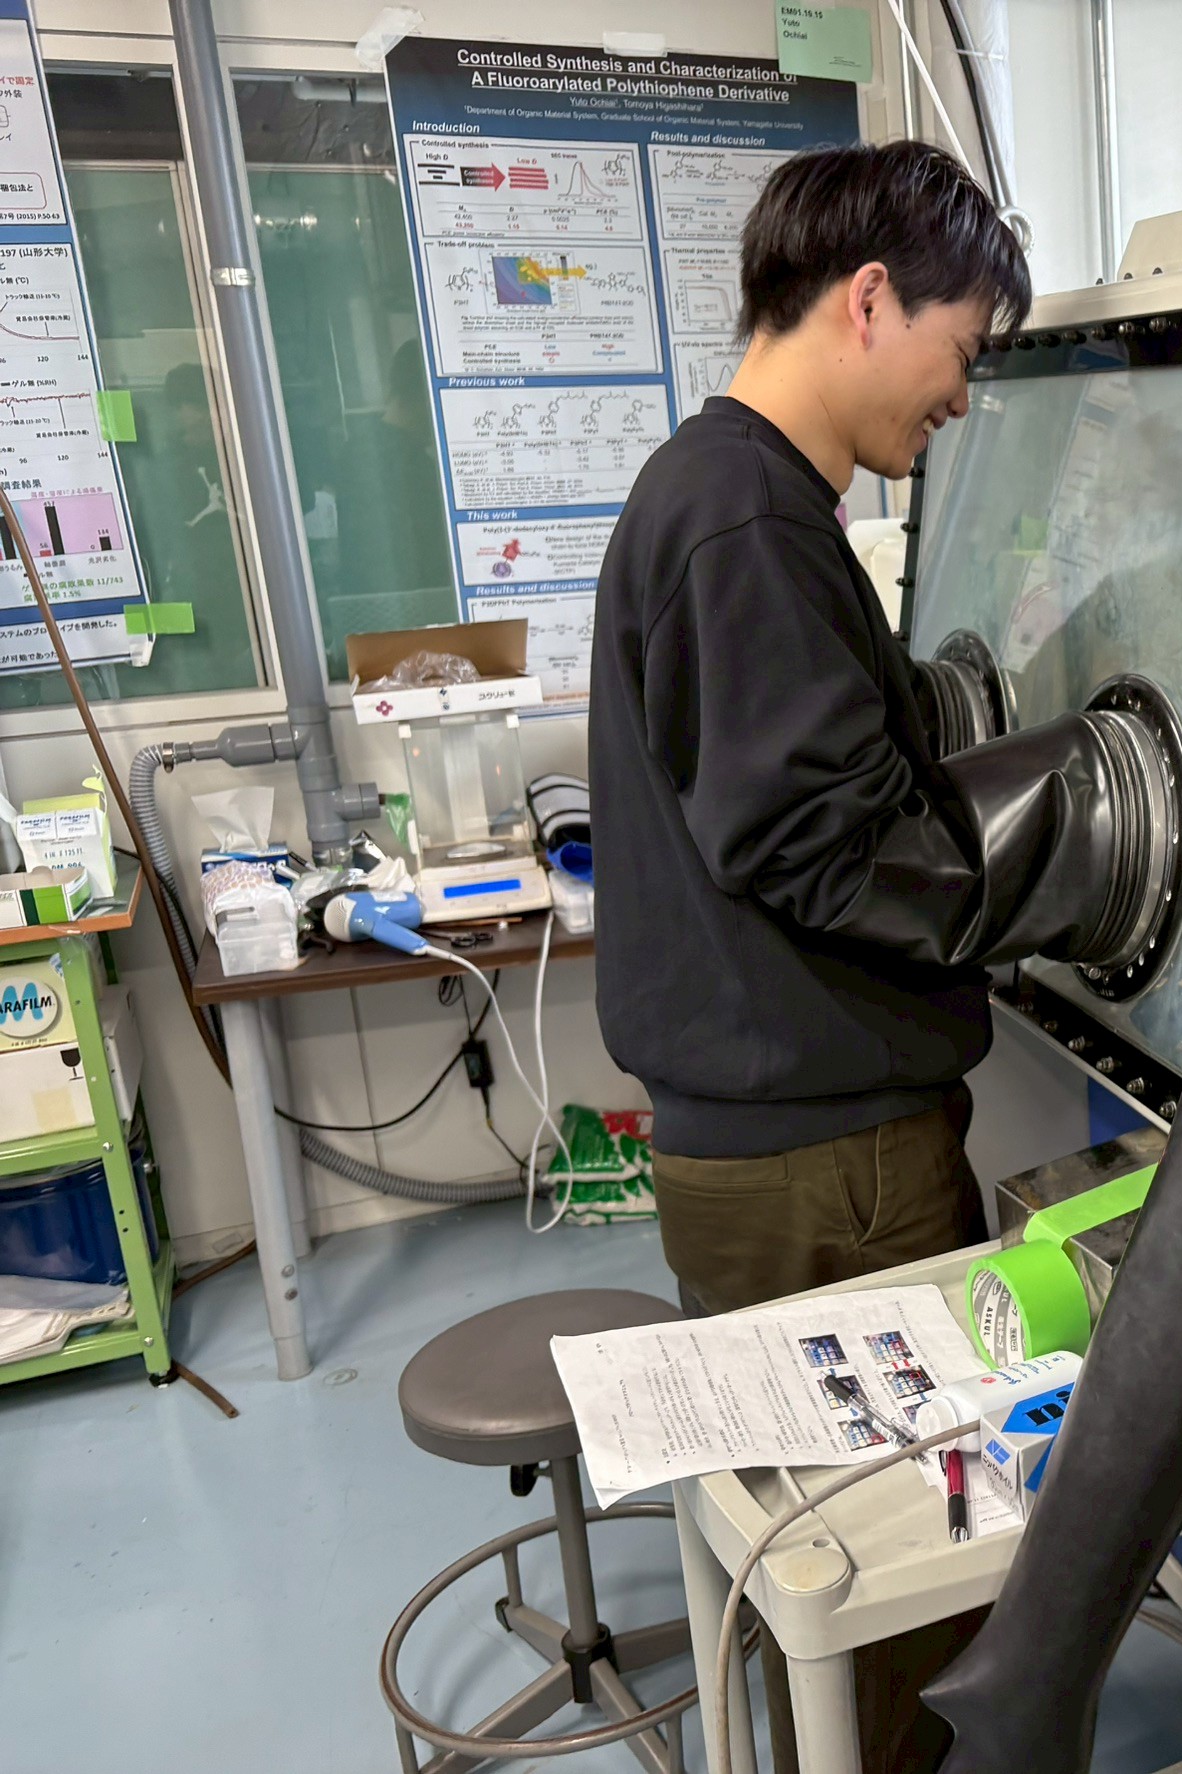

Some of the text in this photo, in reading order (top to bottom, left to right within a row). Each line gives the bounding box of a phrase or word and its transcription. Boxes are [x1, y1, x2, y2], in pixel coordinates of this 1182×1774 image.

[457, 49, 542, 68] Controlled
[546, 54, 623, 72] Synthesis
[628, 60, 655, 74] and
[660, 60, 779, 82] Characterization
[471, 71, 790, 102] A Fluoroarylated Polythiophene Derivative
[508, 108, 515, 116] of
[516, 109, 543, 119] Organic
[544, 110, 570, 119] Material
[412, 120, 480, 134] Introduction
[422, 139, 489, 150] Controlled synthesis
[650, 131, 766, 147] Results and discussion
[19, 246, 68, 258] (山形大学)
[468, 242, 494, 250] problem
[448, 376, 526, 387] Previous work
[58, 454, 70, 462] 120
[467, 510, 518, 521] This work
[476, 581, 595, 596] Results and discussion
[0, 620, 117, 639] ステムのプロイプを開発した。
[984, 1306, 994, 1336] ASKUL
